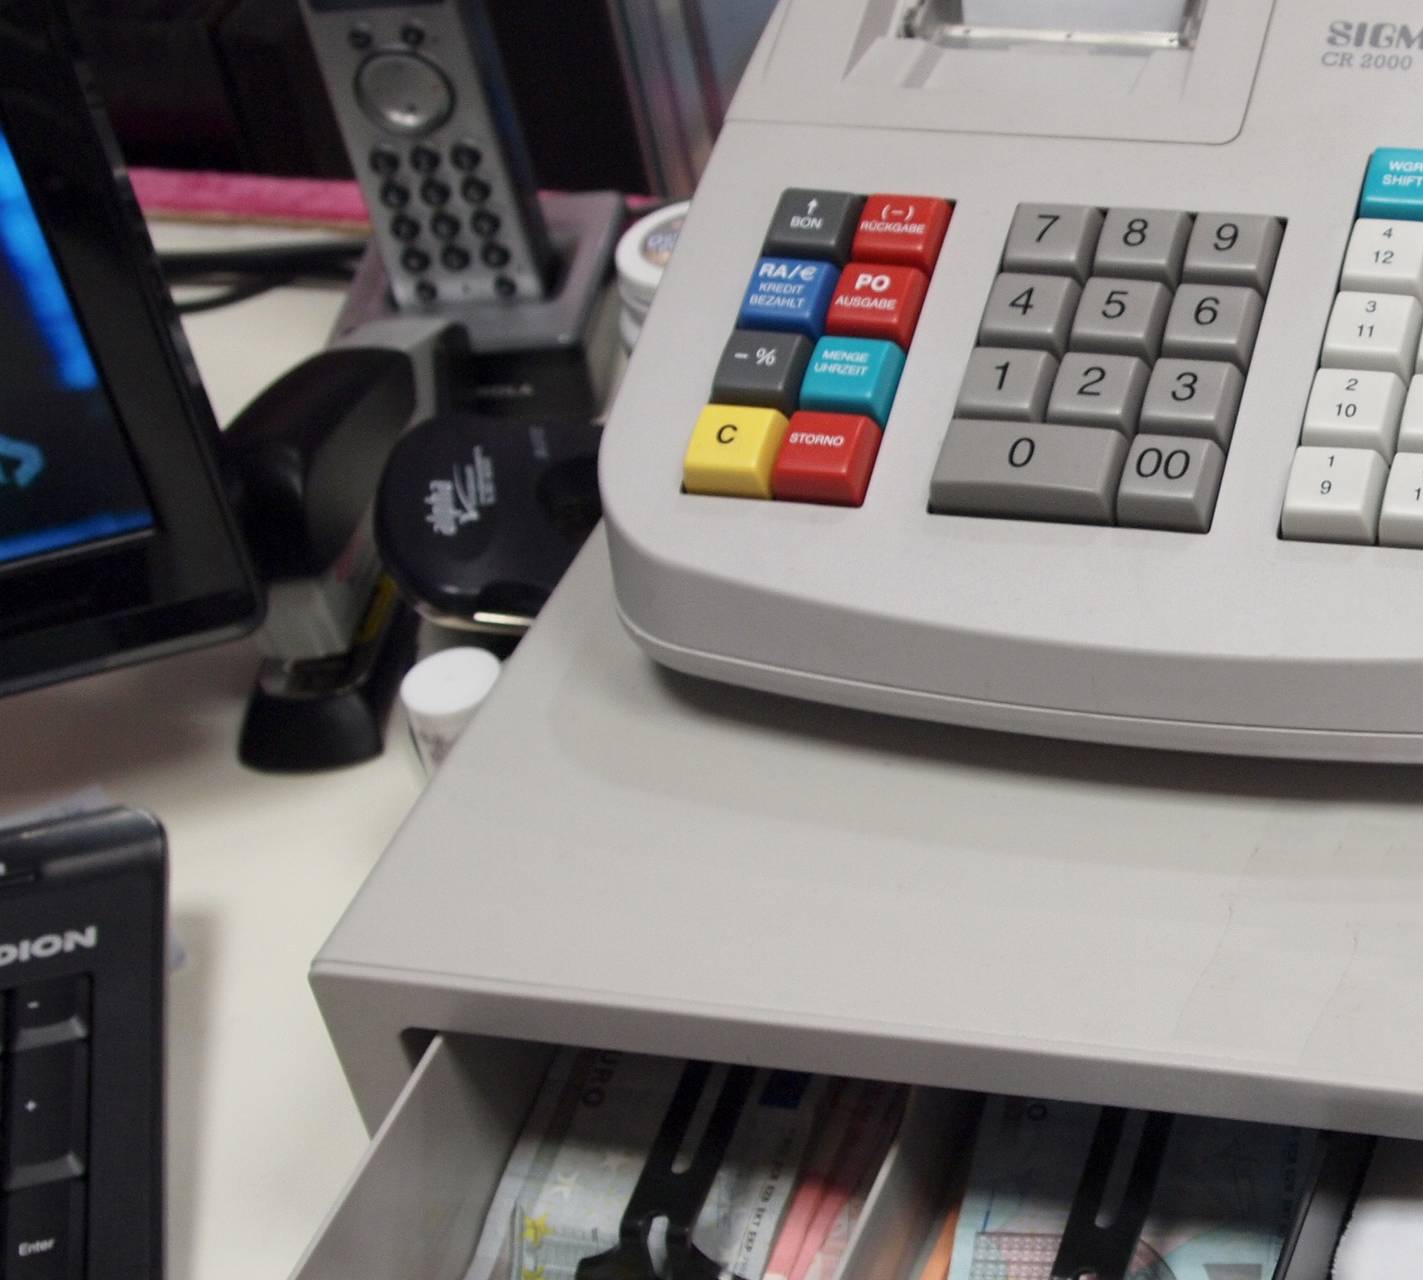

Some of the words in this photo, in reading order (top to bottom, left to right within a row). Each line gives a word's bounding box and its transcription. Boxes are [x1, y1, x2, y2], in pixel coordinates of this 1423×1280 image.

[1321, 51, 1353, 68] CR
[1360, 53, 1413, 71] 2000
[789, 215, 823, 229] BON
[860, 219, 926, 235] RÜCKGABE
[1034, 214, 1060, 243] 7
[1122, 218, 1149, 247] 8
[1212, 223, 1239, 252] 9
[1383, 228, 1393, 239] 4
[1373, 251, 1395, 265] 12
[758, 263, 817, 282] RA/€
[758, 282, 805, 295] KREDIT
[854, 274, 892, 293] PO
[749, 295, 805, 309] BEZAHLT
[835, 296, 897, 311] AUSGABE
[1008, 287, 1036, 316] 4
[1101, 291, 1129, 320] 5
[1365, 300, 1377, 314] 3
[1193, 297, 1220, 326] 6
[1357, 324, 1375, 338] 11
[755, 347, 777, 366] %
[821, 349, 869, 364] MENGE
[813, 361, 870, 377] UHRZEIT
[993, 361, 1011, 391] 1
[1076, 366, 1106, 396] 2
[1170, 372, 1199, 402] 3
[1345, 378, 1358, 391] 2
[1335, 403, 1357, 418] 10
[716, 425, 738, 444] C
[788, 432, 846, 447] STORNO
[1008, 437, 1036, 468] 0
[1327, 455, 1335, 467] 1
[1135, 447, 1191, 480] 00
[1320, 480, 1332, 495] 9
[18, 1238, 55, 1257] Enter
